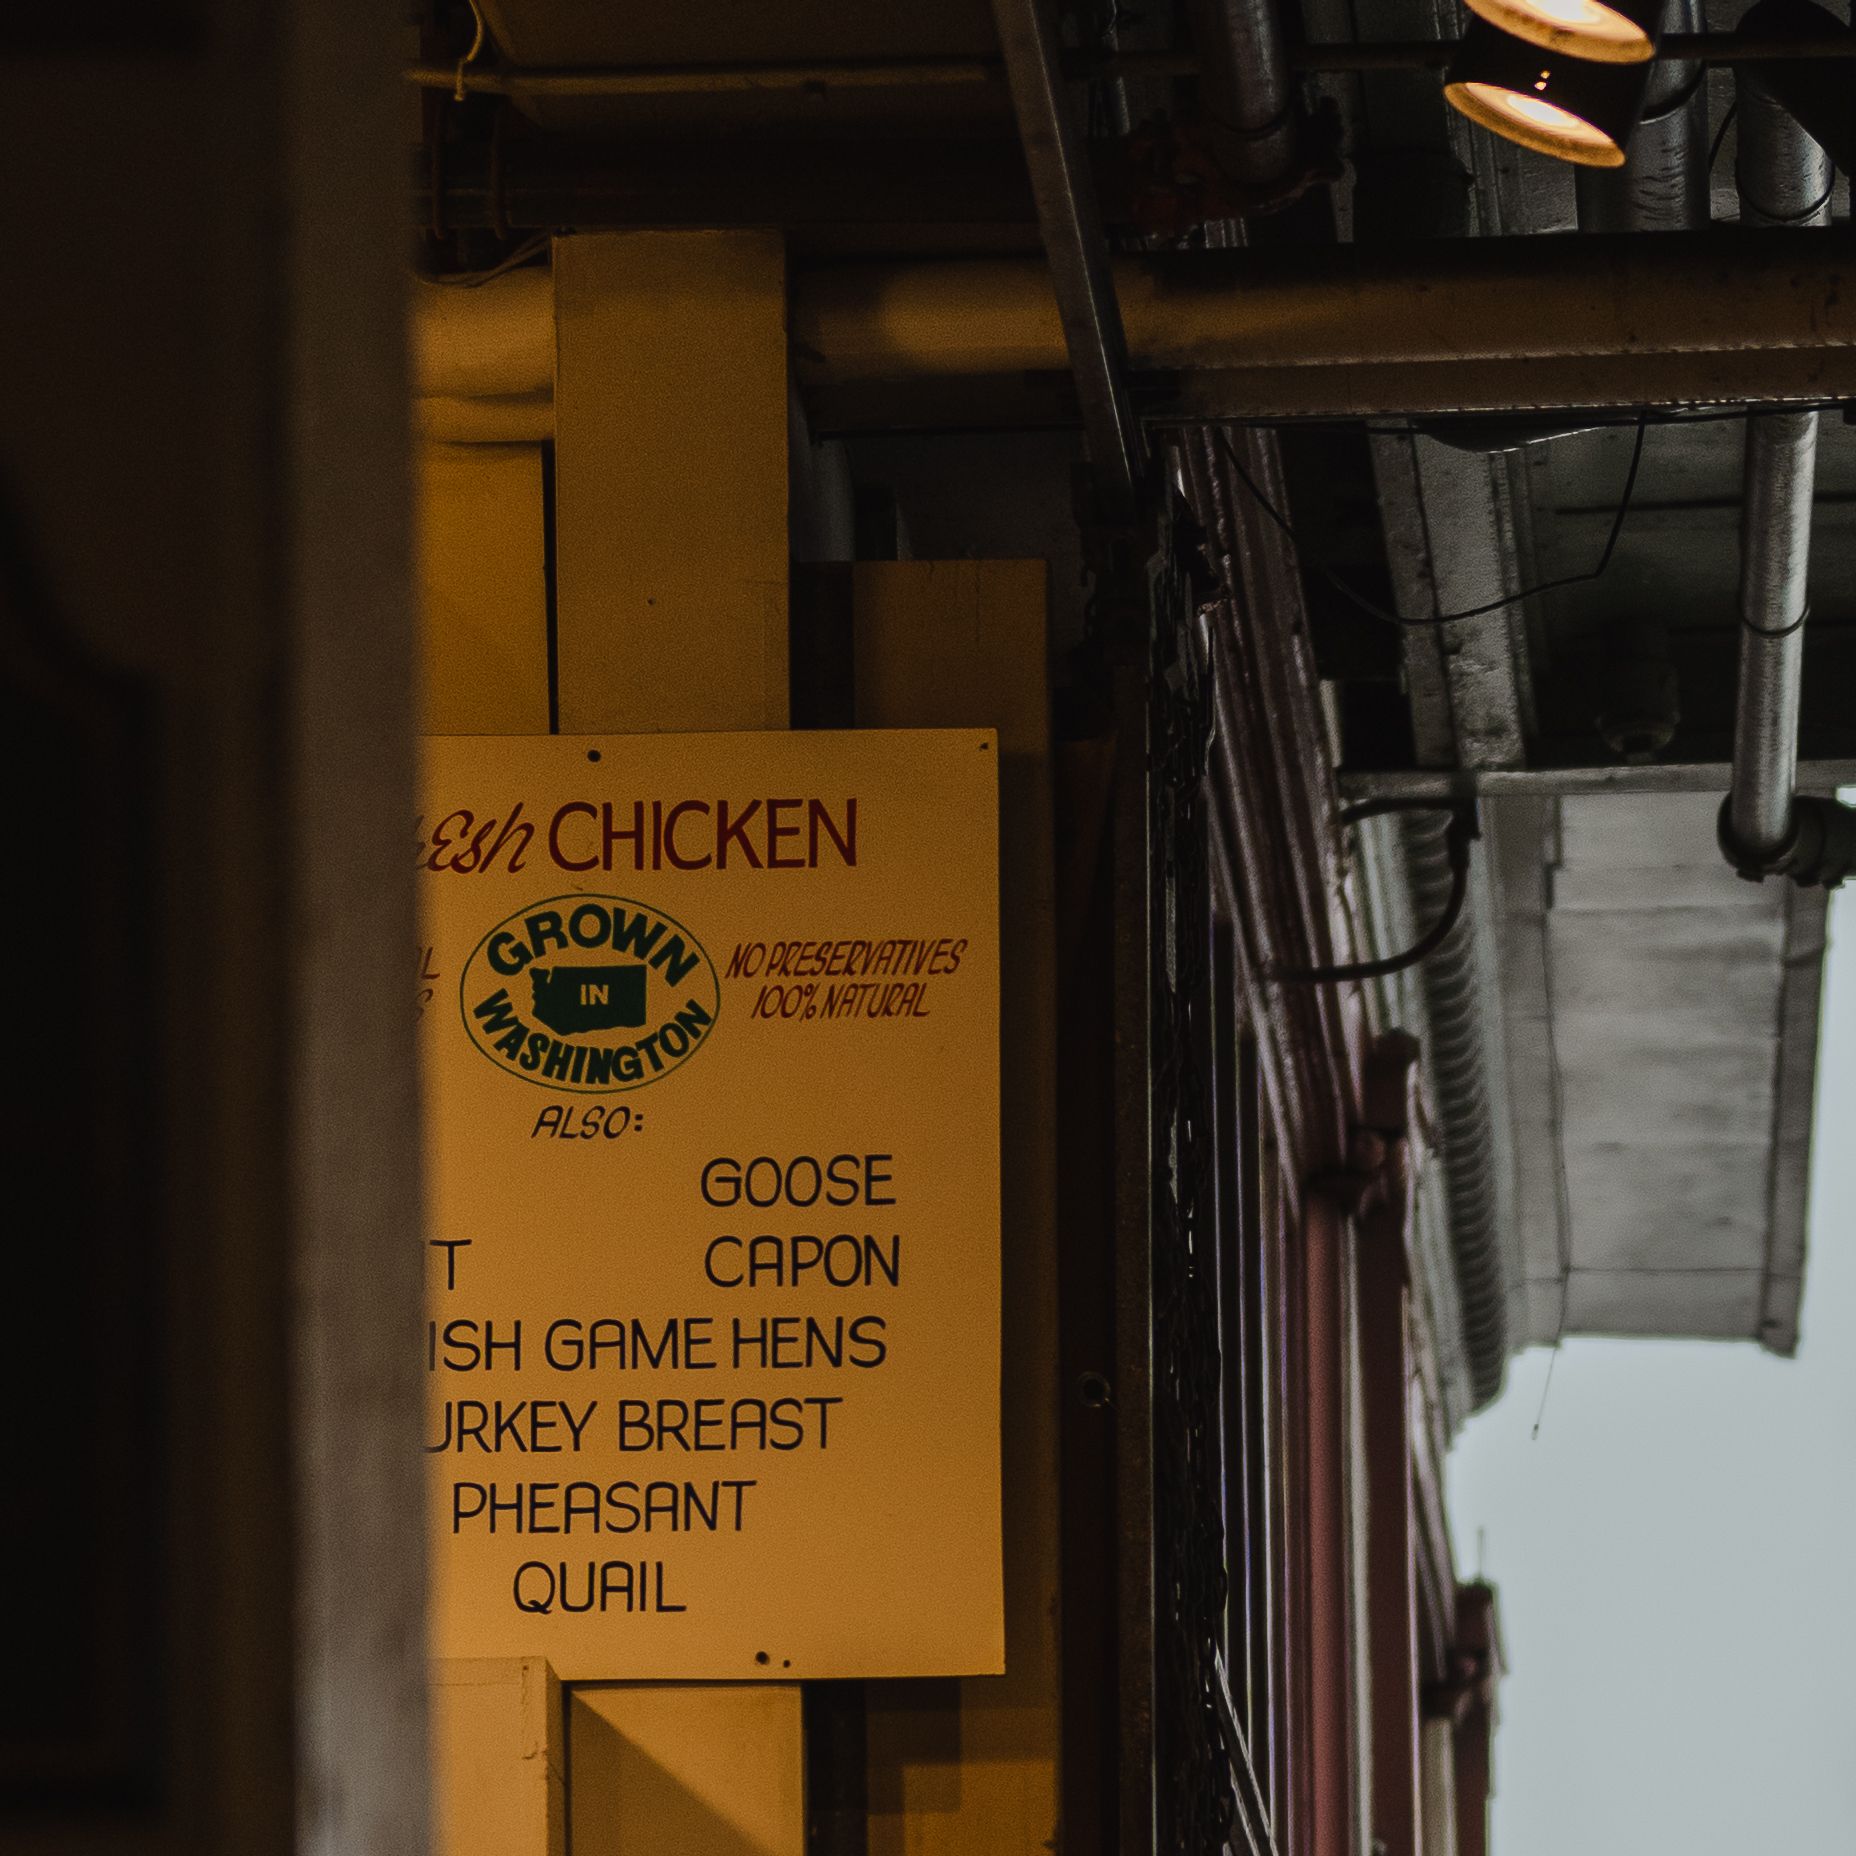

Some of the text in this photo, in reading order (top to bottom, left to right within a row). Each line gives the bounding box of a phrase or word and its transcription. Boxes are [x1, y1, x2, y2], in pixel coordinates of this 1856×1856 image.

[548, 798, 858, 872] CHICKEN
[486, 903, 700, 989] GROWN
[725, 938, 968, 979] NO PRESERVATIVES
[579, 982, 610, 1006] IN
[750, 982, 931, 1021] 100% NATURAL
[472, 988, 713, 1085] WASHINGTON
[531, 1105, 645, 1140] ALSO:
[700, 1153, 896, 1208] GOOSE
[704, 1234, 901, 1288] CAPON
[544, 1317, 716, 1370] GAME
[731, 1316, 888, 1369] HENS
[618, 1396, 843, 1452] BREAST
[452, 1480, 757, 1535] PHEASANT
[512, 1561, 688, 1615] QUAIL
